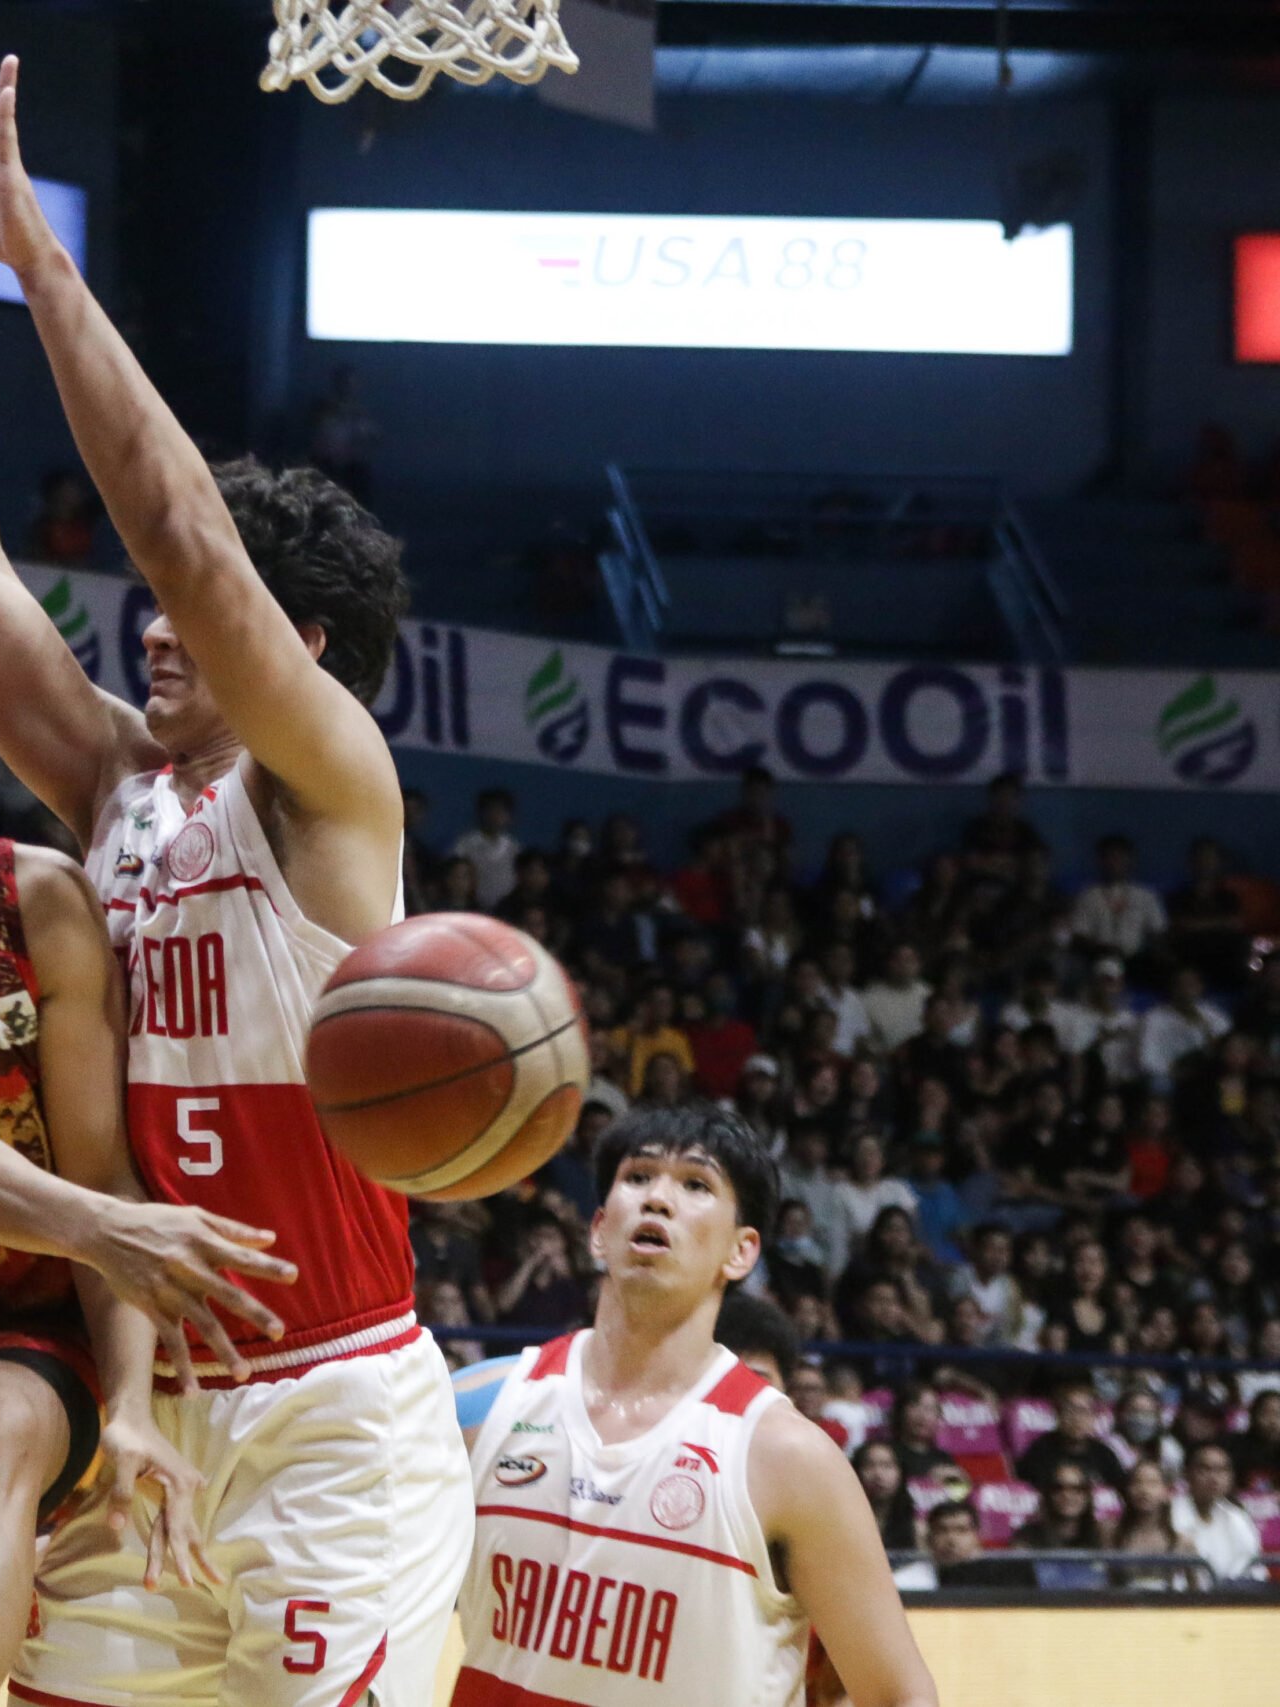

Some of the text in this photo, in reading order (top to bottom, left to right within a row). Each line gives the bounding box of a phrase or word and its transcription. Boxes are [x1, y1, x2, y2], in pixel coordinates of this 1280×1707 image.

[591, 233, 869, 291] USA 88
[606, 655, 1070, 783] EcoOil
[176, 1097, 224, 1176] 5
[282, 1600, 330, 1675] 5
